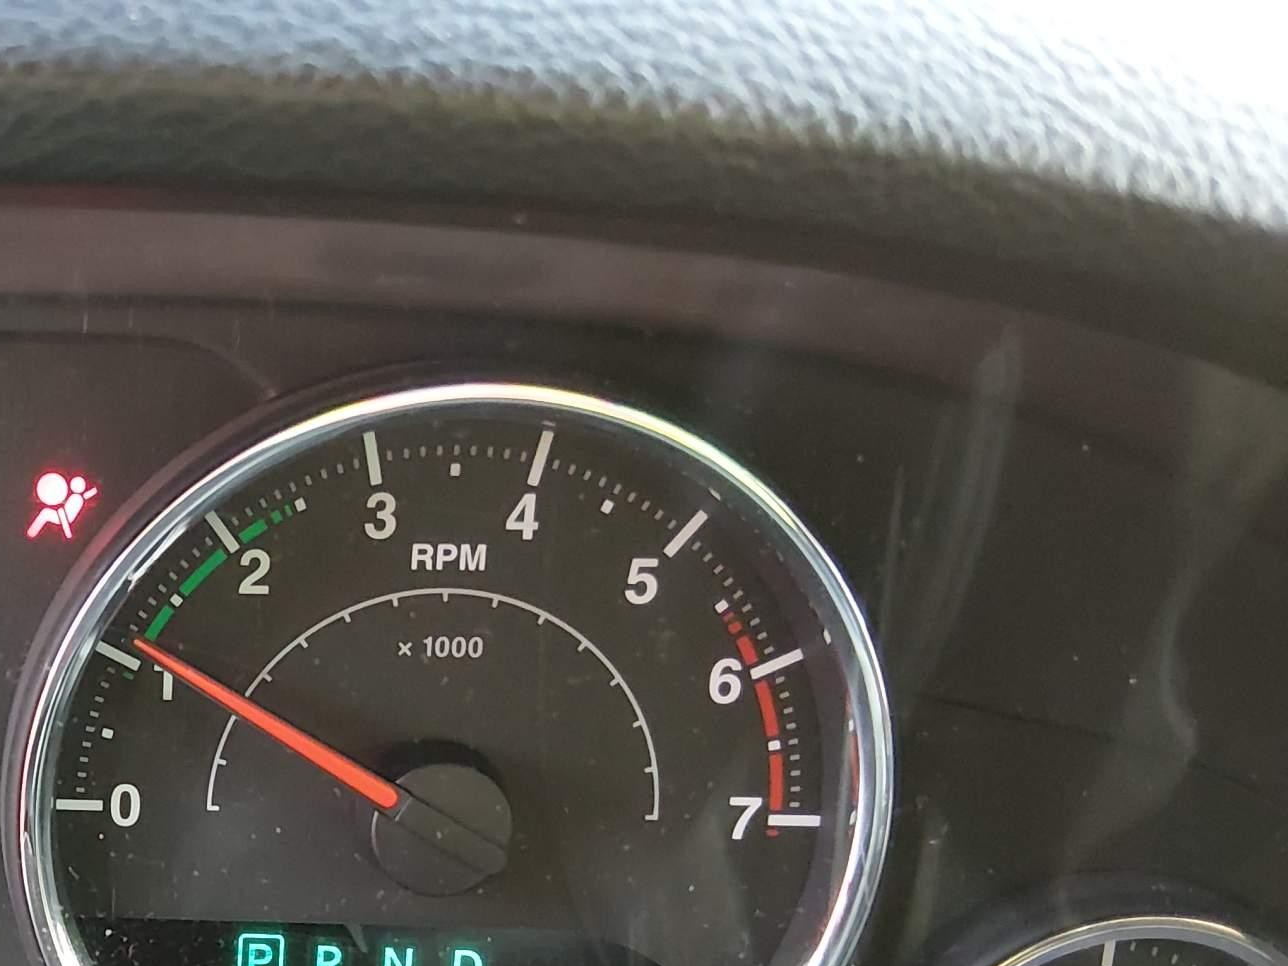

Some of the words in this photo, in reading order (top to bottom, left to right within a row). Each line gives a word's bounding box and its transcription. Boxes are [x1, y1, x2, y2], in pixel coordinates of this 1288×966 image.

[364, 491, 397, 540] 3
[505, 493, 539, 540] 4
[238, 548, 271, 595] 2
[411, 543, 487, 571] RPM
[624, 557, 659, 605] 5
[423, 636, 484, 658] 1000
[708, 657, 742, 705] 6
[110, 783, 141, 827] 0
[729, 796, 763, 840] 7
